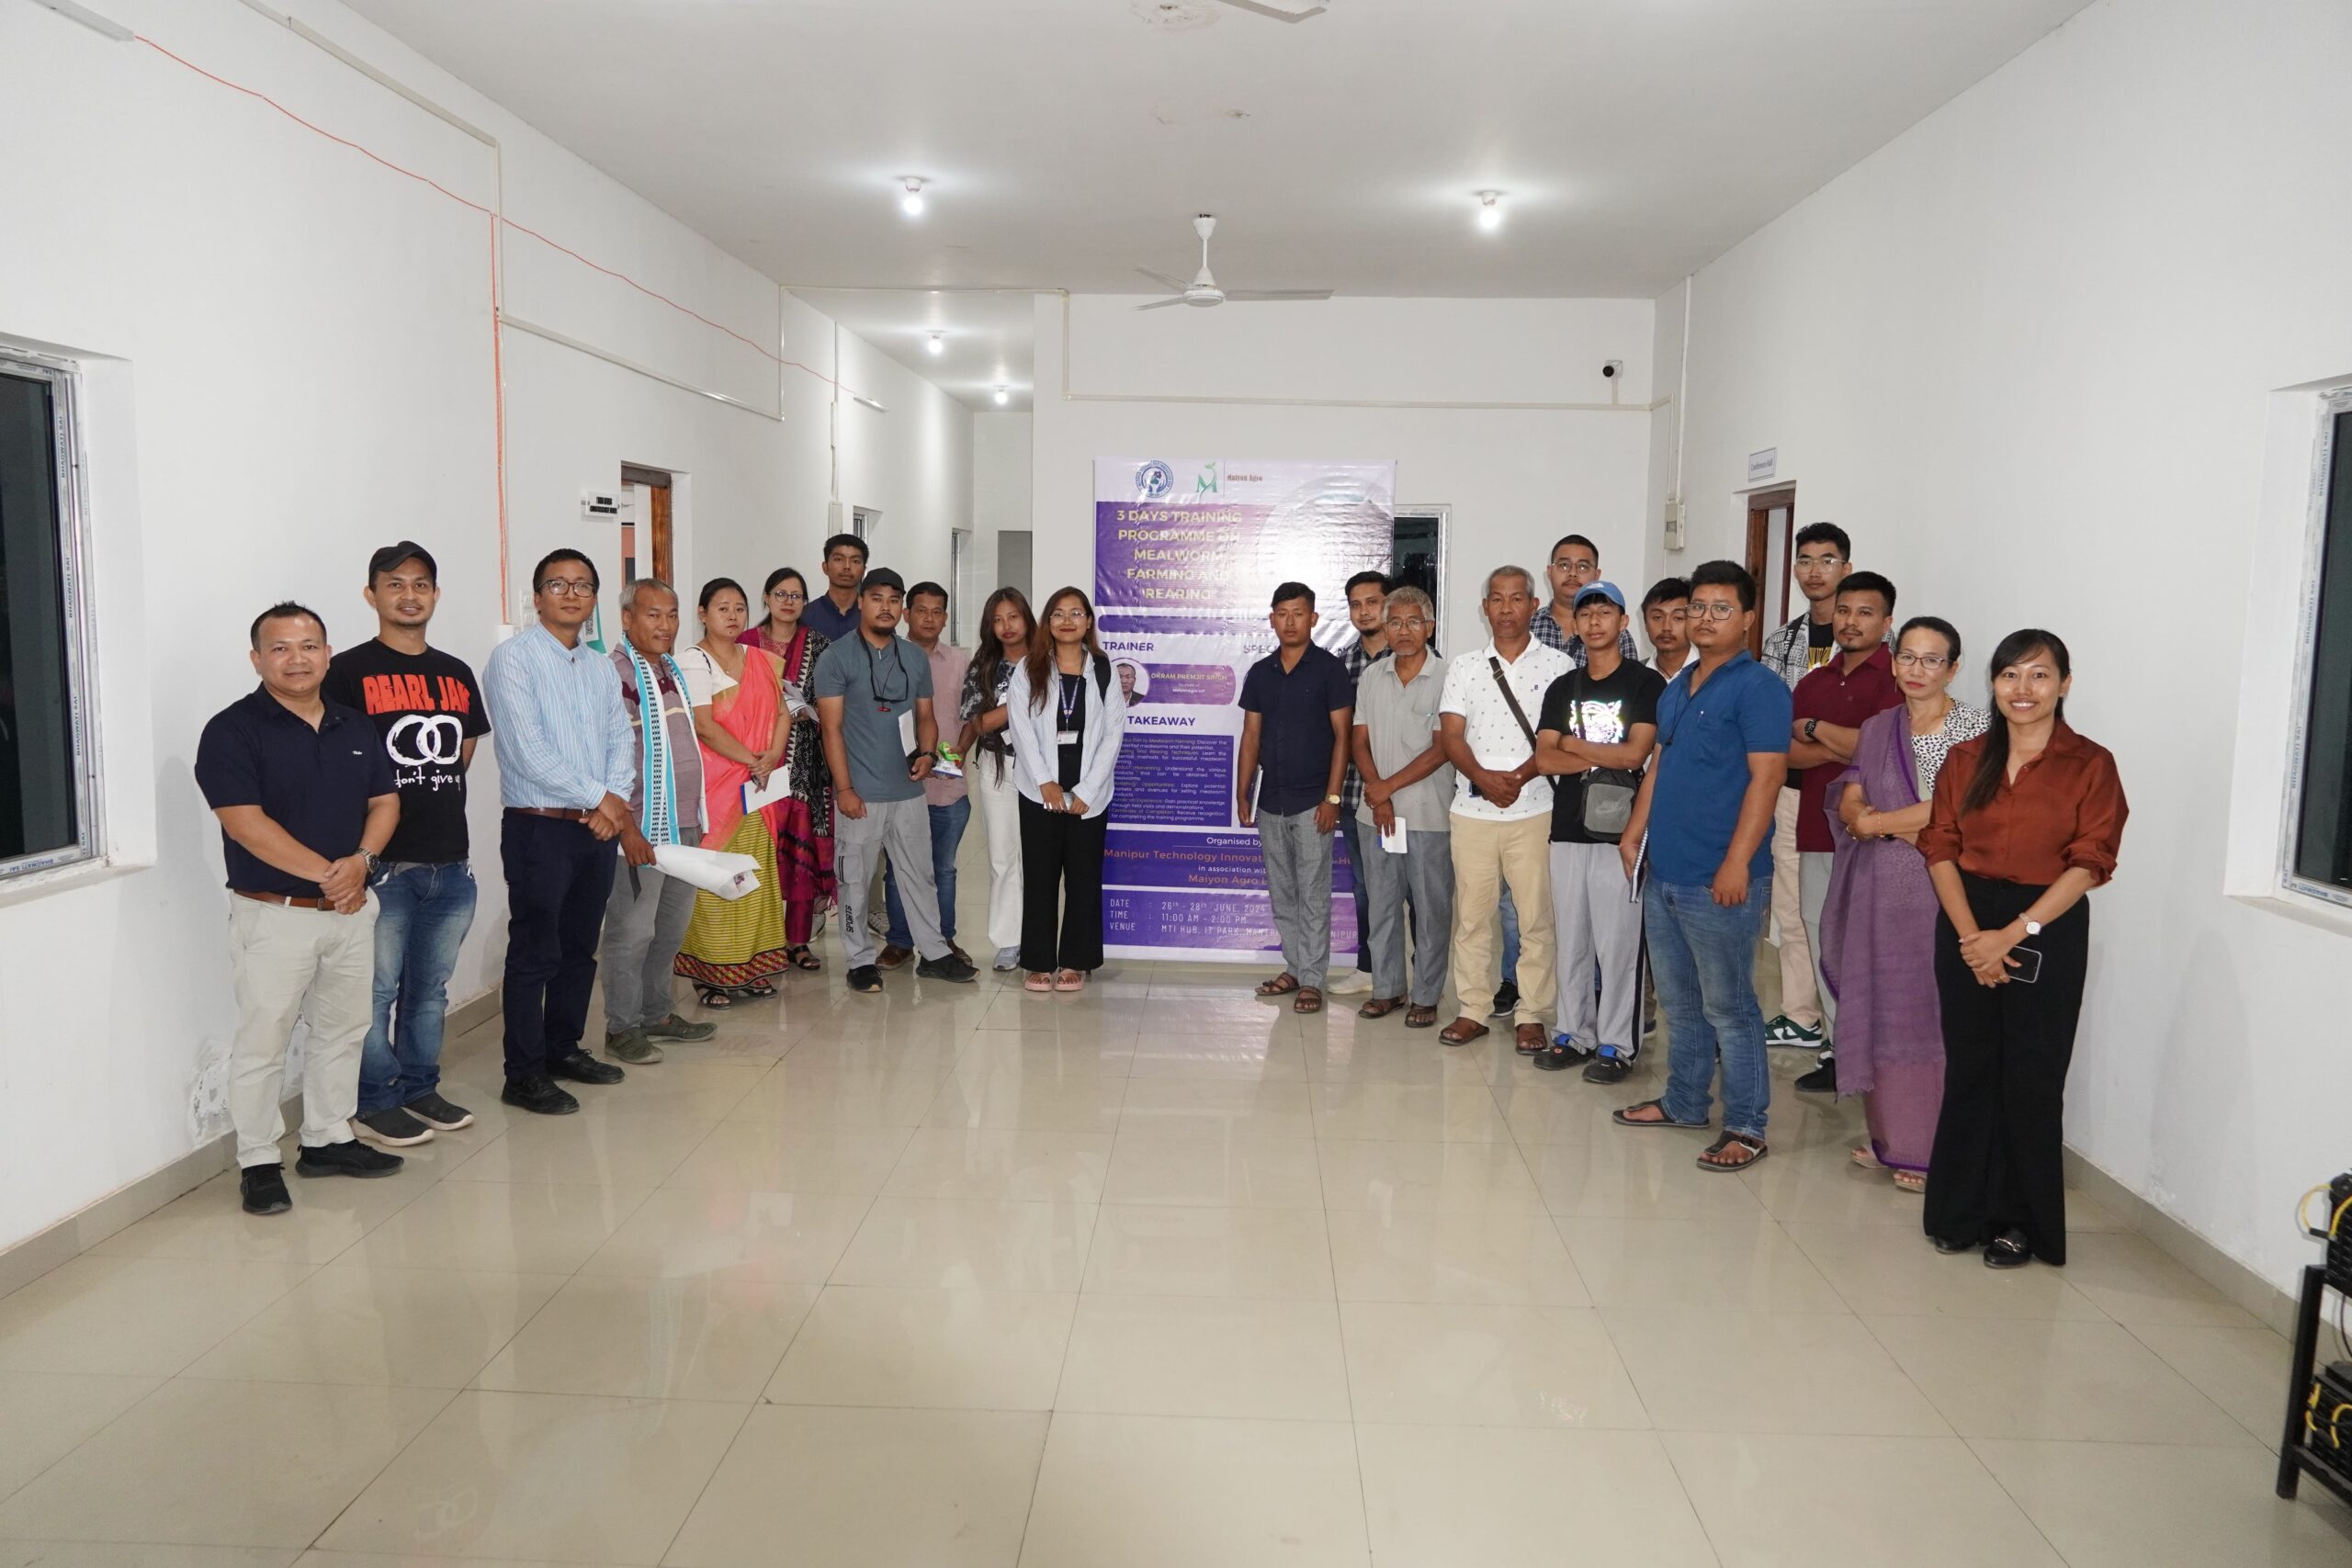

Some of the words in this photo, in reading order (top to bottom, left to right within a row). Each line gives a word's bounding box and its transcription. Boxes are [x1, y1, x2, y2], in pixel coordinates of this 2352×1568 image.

[1117, 511, 1125, 521] 3
[1128, 511, 1168, 521] DAYS
[1171, 512, 1242, 523] TRAINING
[1118, 530, 1217, 541] PROGRAMME
[1134, 549, 1223, 561] MEALWORM
[1126, 569, 1194, 581] FARMING
[1146, 588, 1212, 600] REARING
[1102, 641, 1154, 651] TRAINER
[362, 673, 435, 716] PEARL
[1127, 716, 1195, 726] TAKEAWAY
[431, 770, 453, 791] give
[1206, 837, 1250, 846] Organised
[1253, 839, 1262, 848] by
[1104, 850, 1149, 860] Manipur
[1153, 851, 1217, 863] Technology
[1220, 852, 1262, 863] Innovat
[1189, 874, 1227, 885] Maiyon
[1231, 875, 1258, 886] Agro
[1110, 899, 1129, 908] DATE
[1190, 902, 1206, 911] 28th
[1244, 904, 1265, 913] 2024
[845, 905, 854, 932] SPORTS
[1161, 914, 1183, 922] 11:00
[1211, 915, 1231, 923] 2:00
[1235, 916, 1247, 924] PM
[1110, 922, 1136, 931] VENUE
[1204, 926, 1212, 934] IT
[1246, 928, 1279, 936] MANTR
